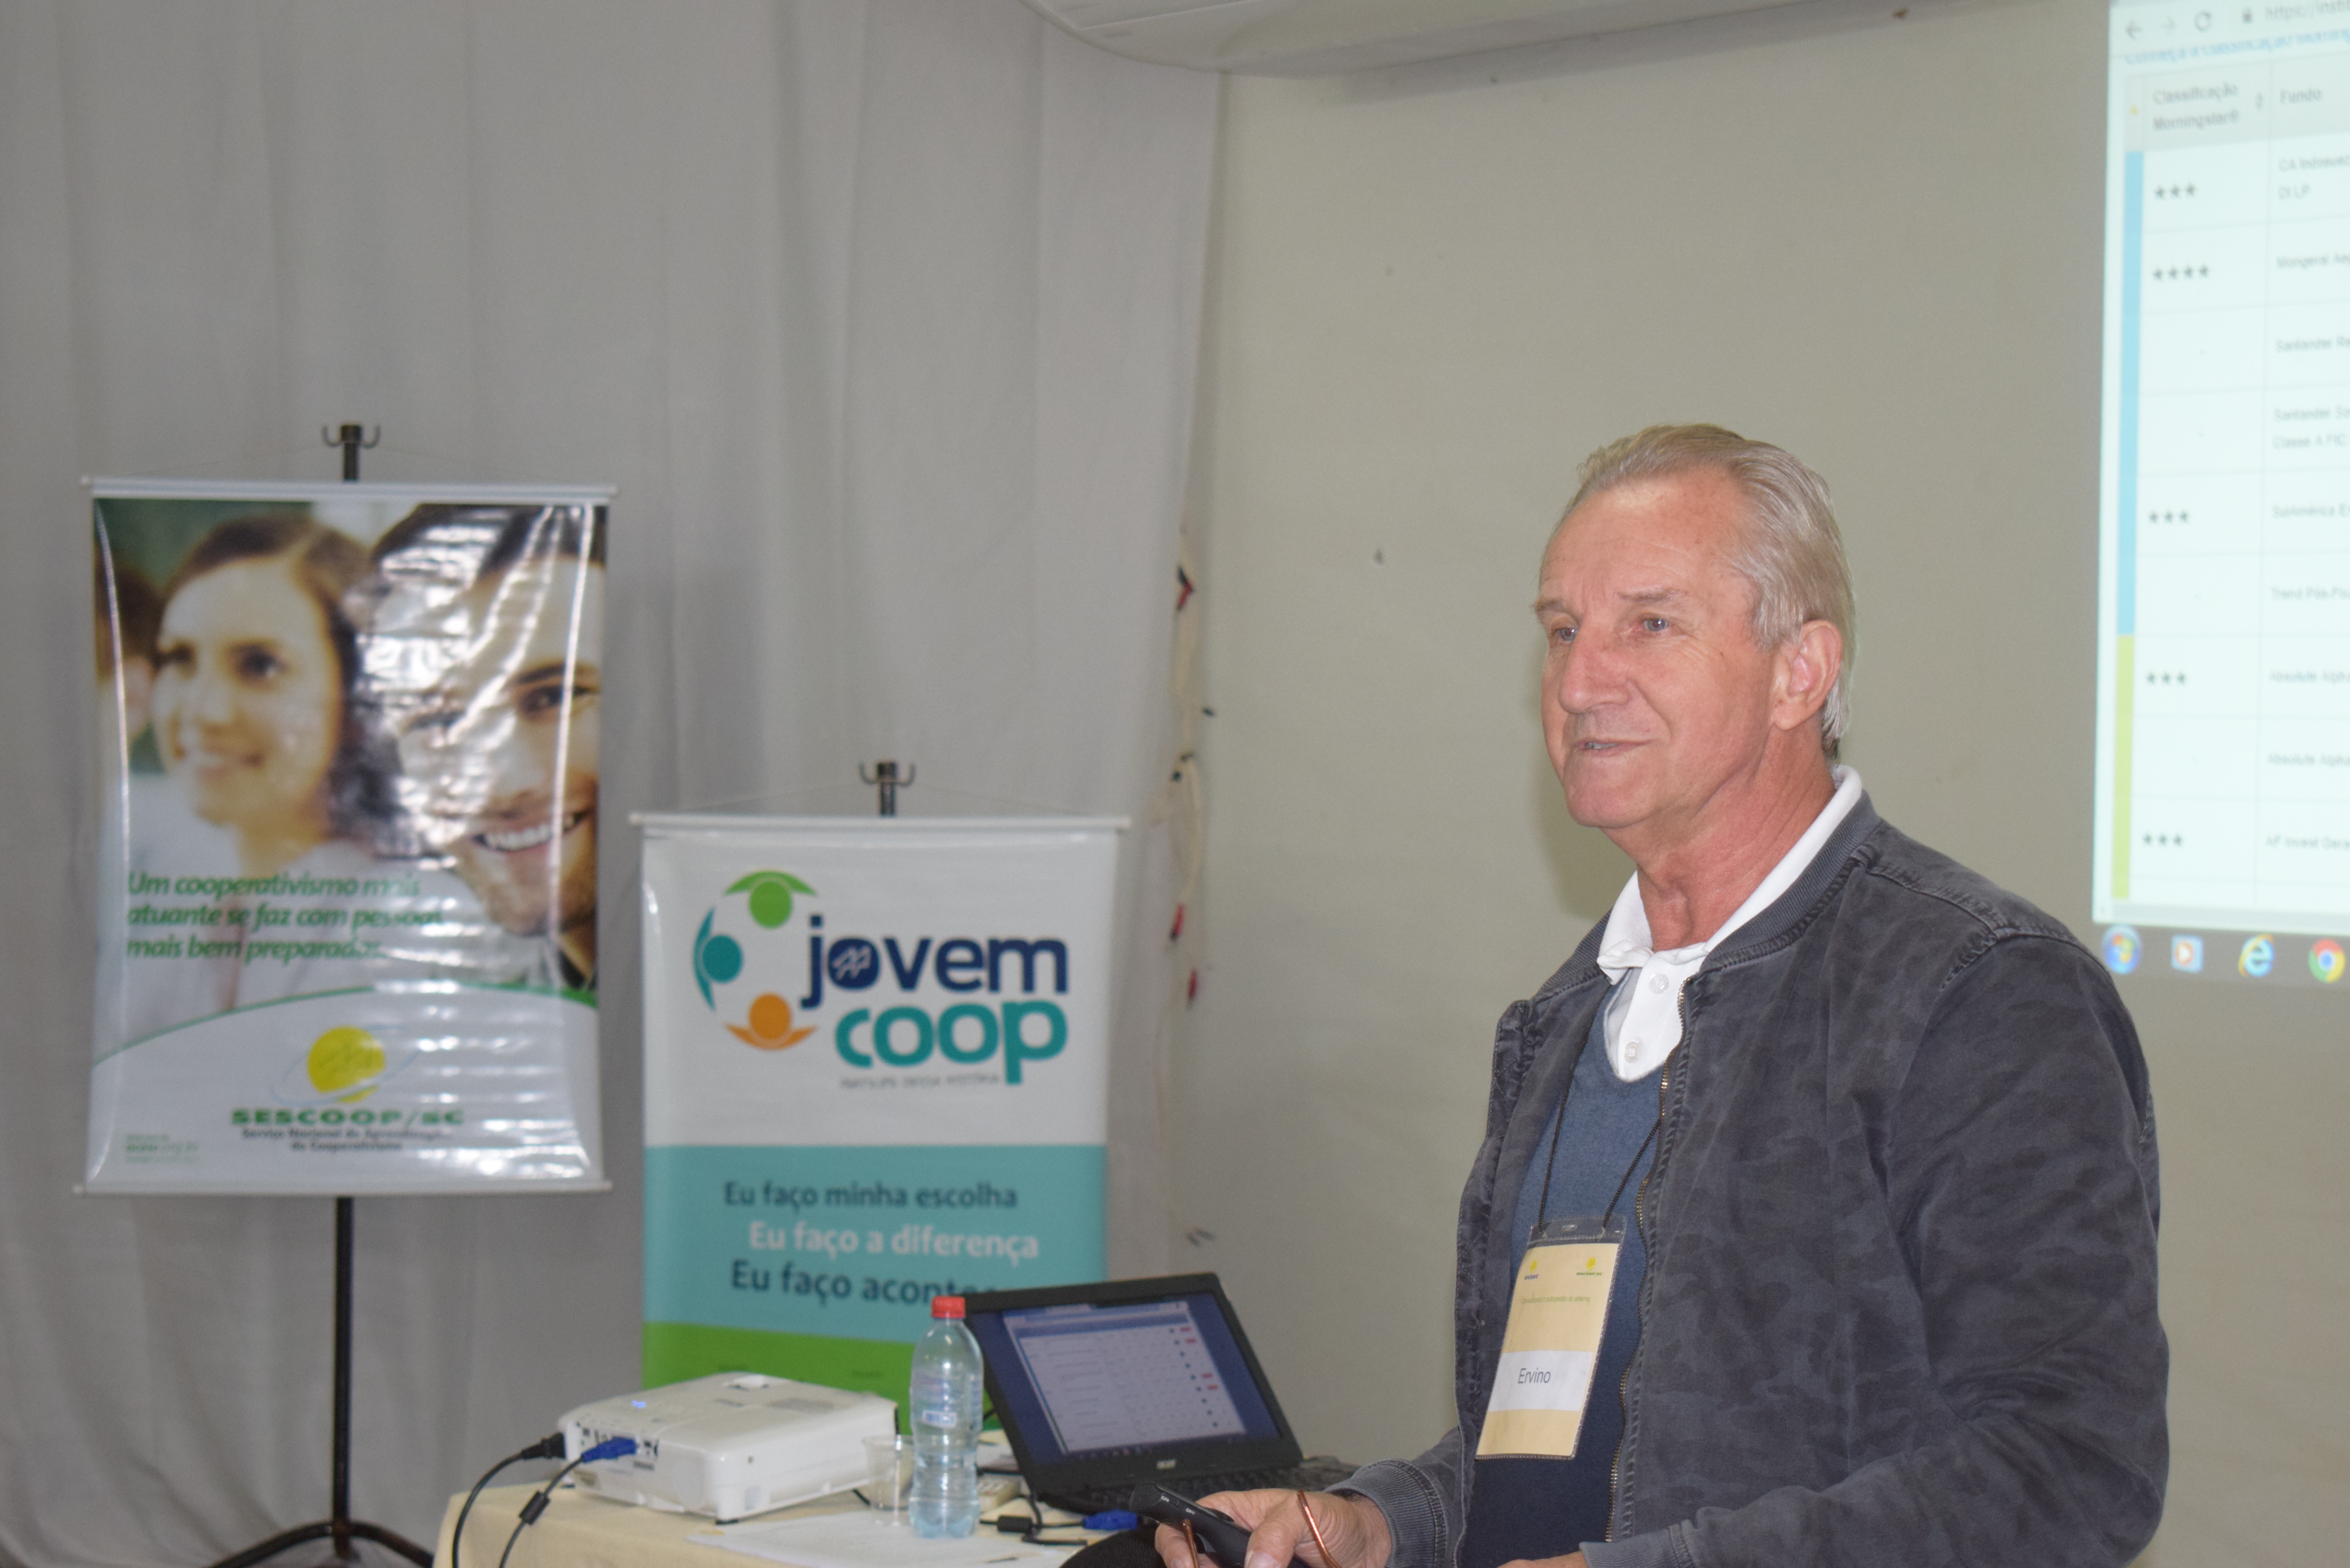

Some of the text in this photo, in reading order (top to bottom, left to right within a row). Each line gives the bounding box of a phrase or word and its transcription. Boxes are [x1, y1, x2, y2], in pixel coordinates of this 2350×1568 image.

[129, 871, 169, 895] Um
[175, 871, 359, 901] cooperativismo
[128, 904, 222, 927] atuante
[252, 901, 291, 933] faz
[296, 909, 347, 927] com
[128, 933, 182, 959] mais
[187, 934, 241, 959] bem
[800, 914, 1069, 1009] jovem
[834, 1000, 1069, 1085] coop
[232, 1109, 465, 1125] SESCOOP/SC
[724, 1179, 1018, 1214] Eu faço minha escolha
[750, 1220, 1039, 1268] Eu faço a diferença
[731, 1258, 771, 1294] Eu
[780, 1260, 853, 1308] faço
[1517, 1367, 1551, 1384] Ervino
